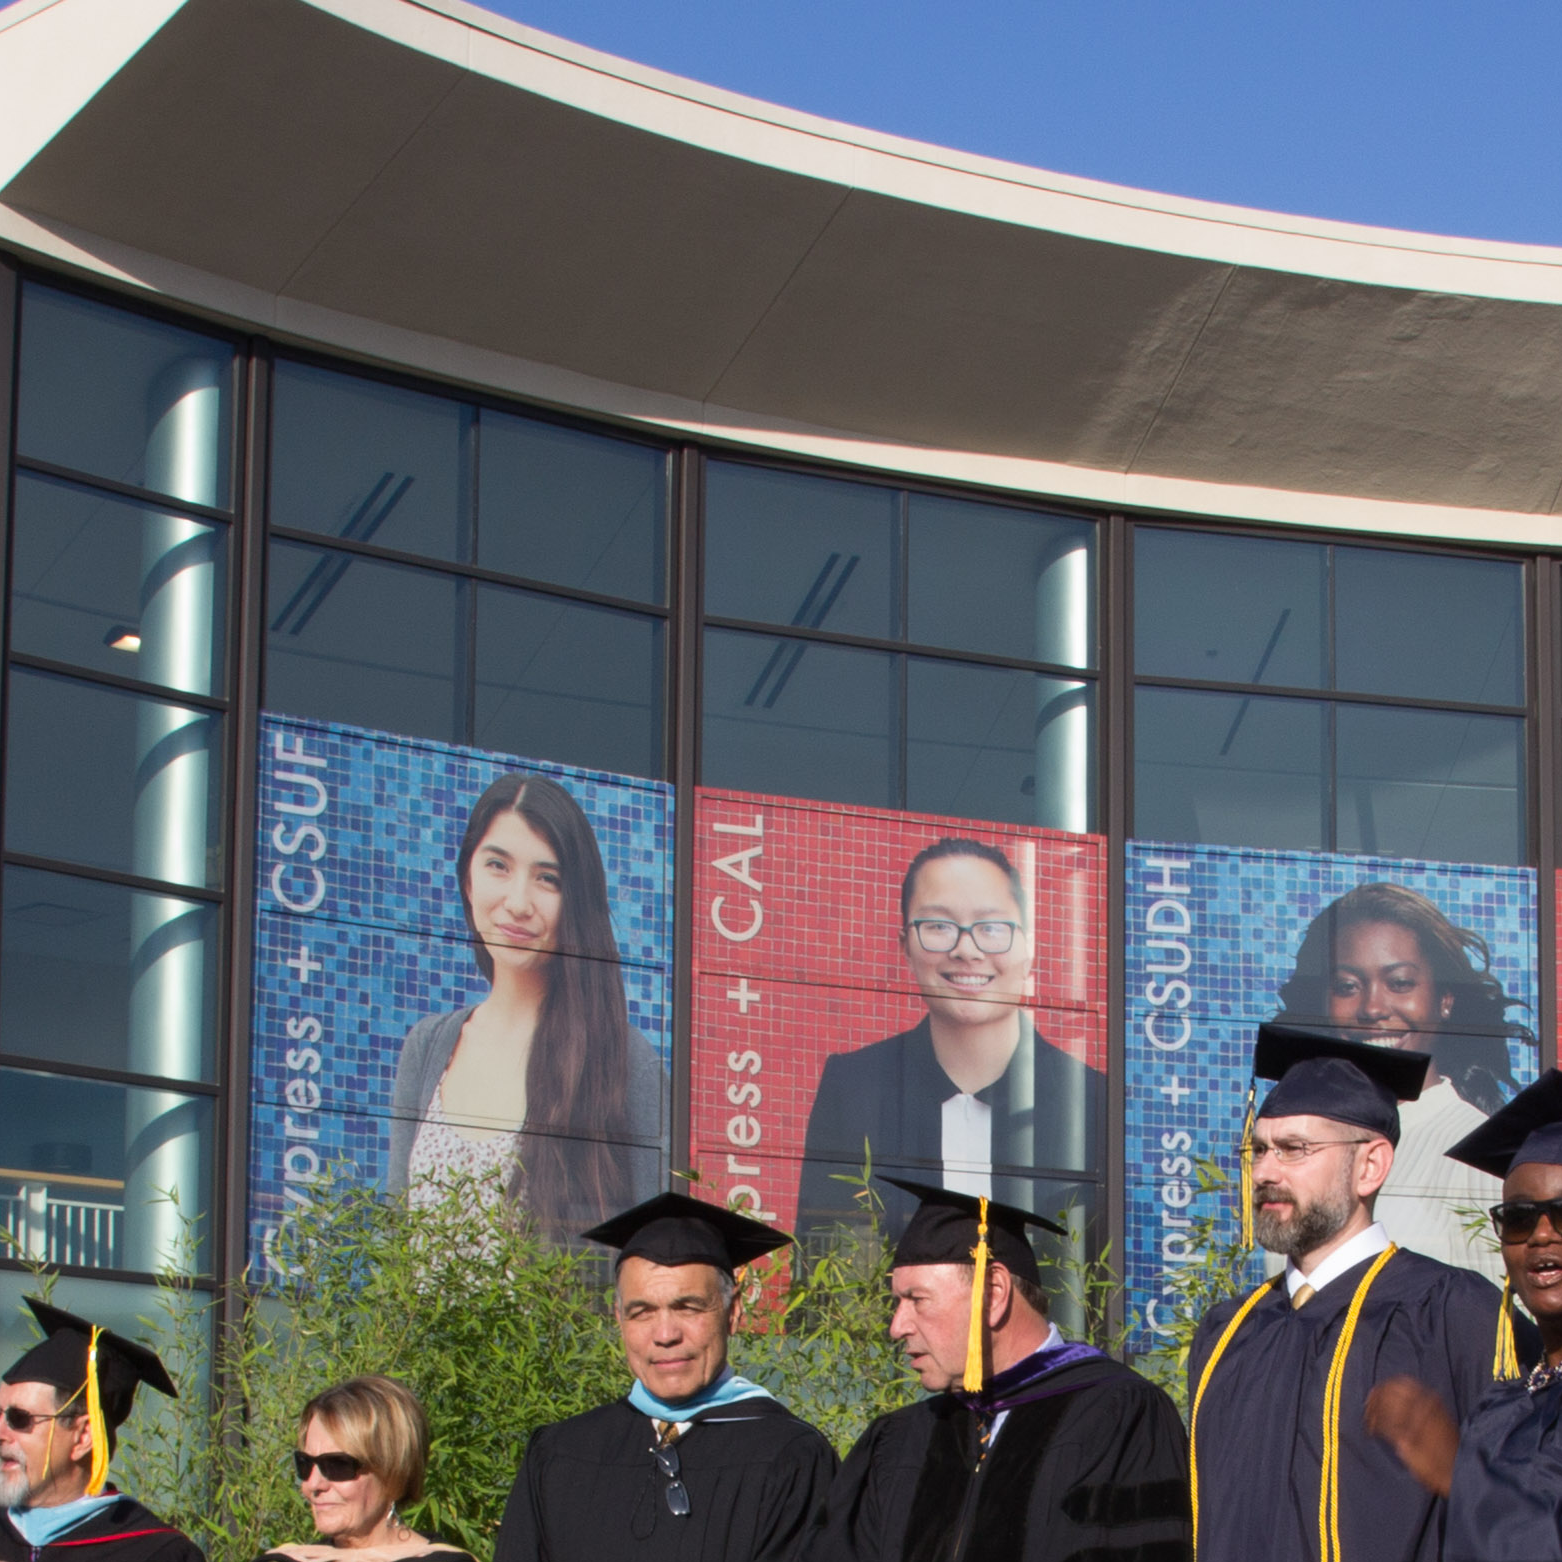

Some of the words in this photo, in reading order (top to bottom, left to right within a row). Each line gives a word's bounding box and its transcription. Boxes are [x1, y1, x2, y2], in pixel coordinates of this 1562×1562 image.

[271, 732, 328, 913] CSUF
[711, 814, 764, 943] CAL
[286, 946, 322, 983] +
[726, 977, 761, 1014] +
[1145, 858, 1192, 1052] CSUDH
[1159, 1074, 1191, 1106] +
[1145, 1131, 1208, 1337] Cypress
